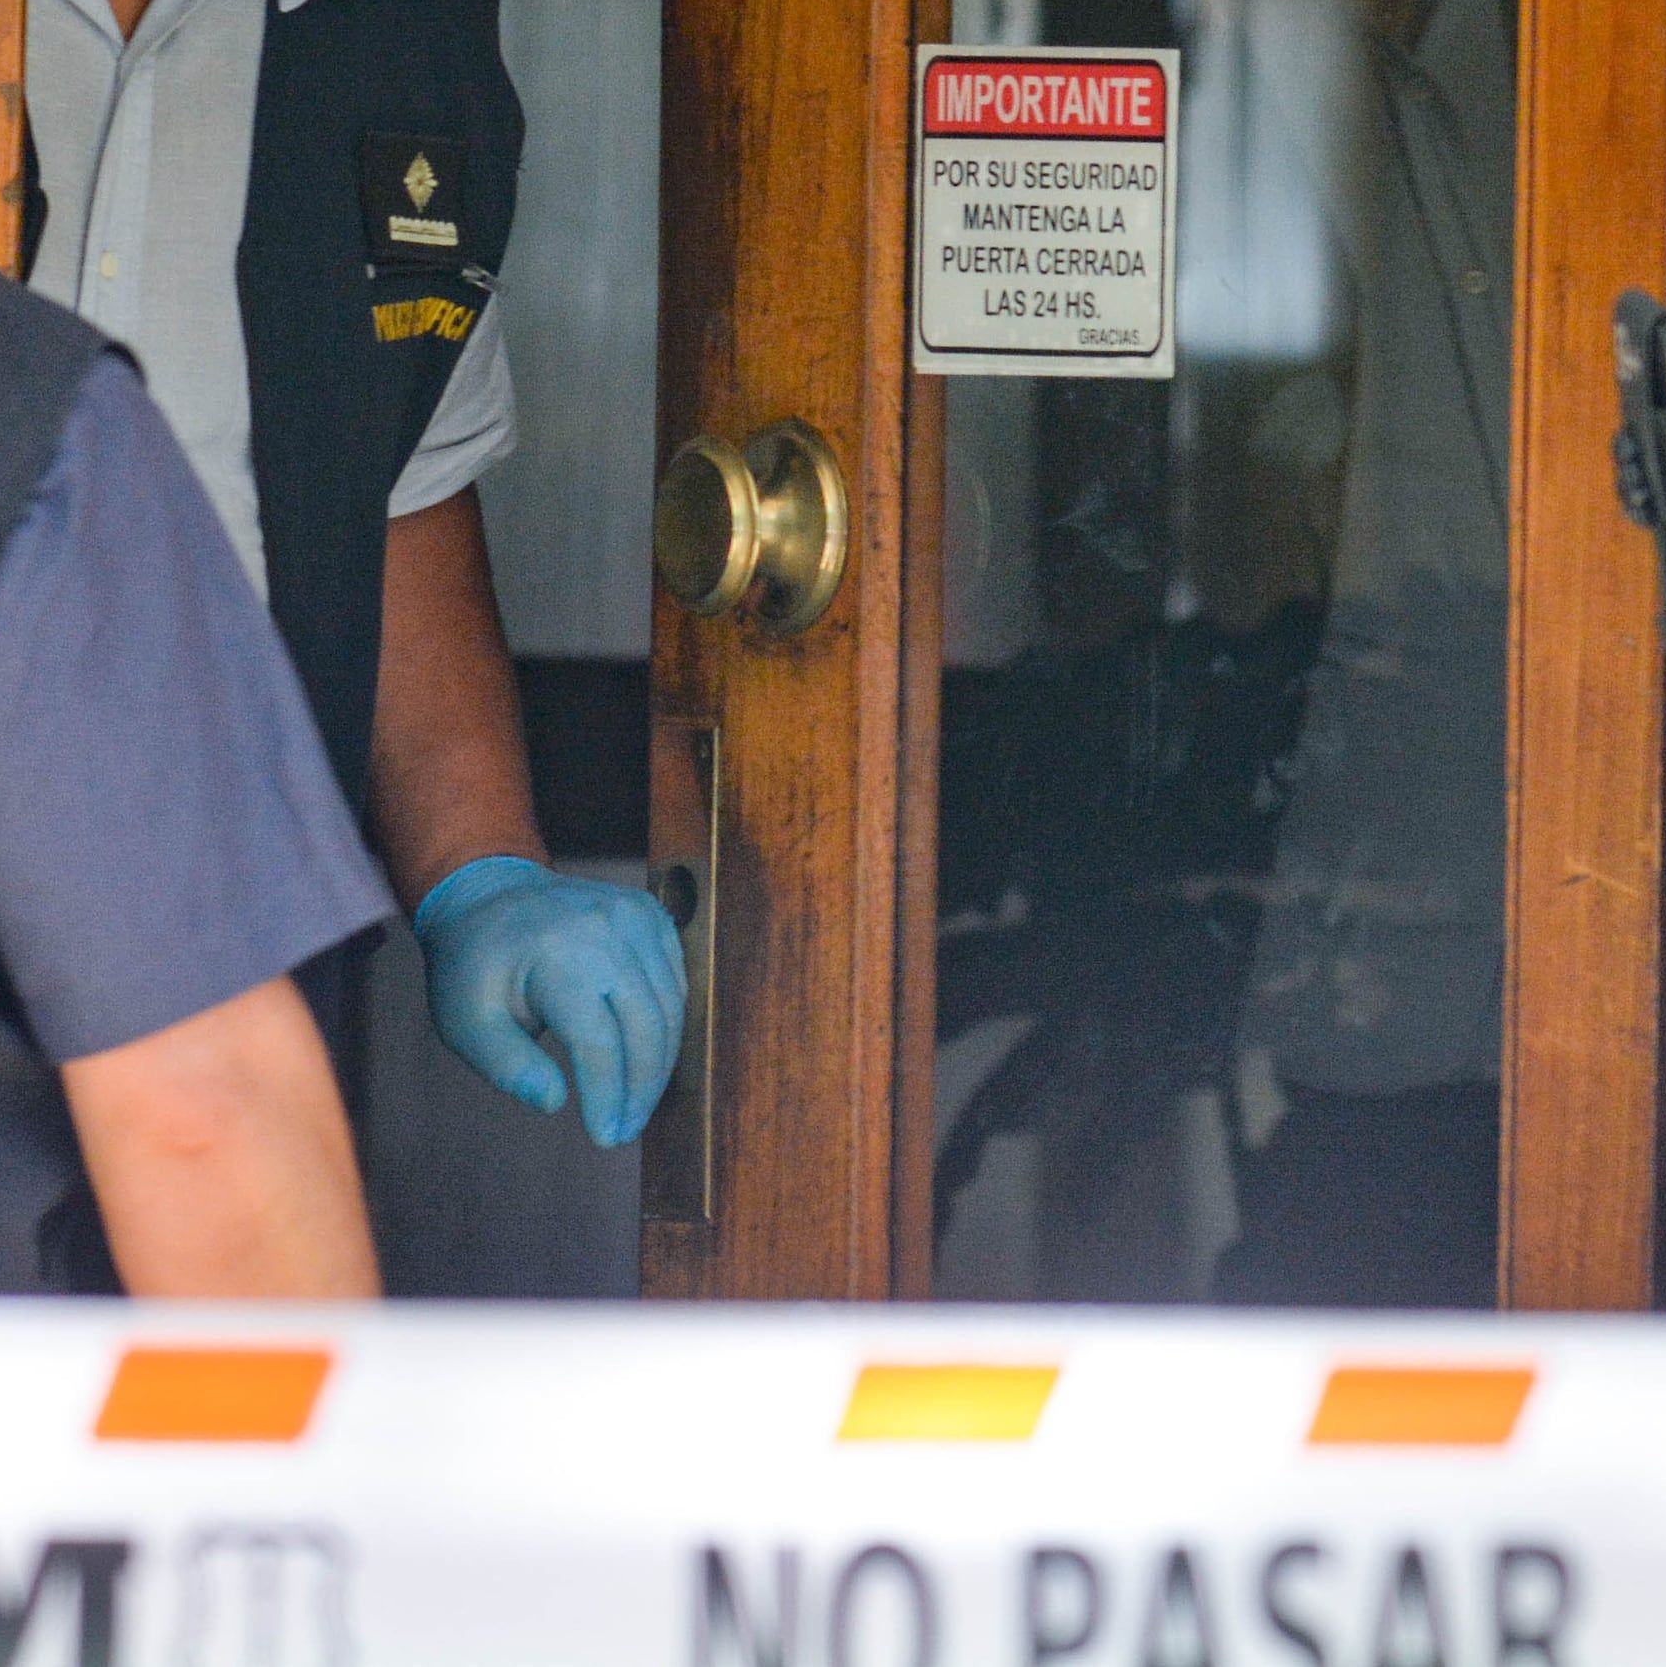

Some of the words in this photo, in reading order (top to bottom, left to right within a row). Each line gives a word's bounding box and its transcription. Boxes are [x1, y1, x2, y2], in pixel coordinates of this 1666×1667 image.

[936, 74, 1152, 126] IMPORTANTE
[933, 160, 980, 187] POR
[987, 160, 1017, 188] SU
[1024, 162, 1158, 191] SEGURIDAD
[963, 203, 1090, 232] MANTENGA
[1098, 207, 1126, 233] LA
[942, 246, 1030, 274] PUERTA
[1036, 248, 1146, 276] CERRADA
[983, 289, 1027, 317] LAS
[1033, 290, 1059, 318] 24
[1065, 291, 1101, 319] HS.
[695, 1539, 940, 1667] NO
[1023, 1539, 1577, 1667] PASAR
